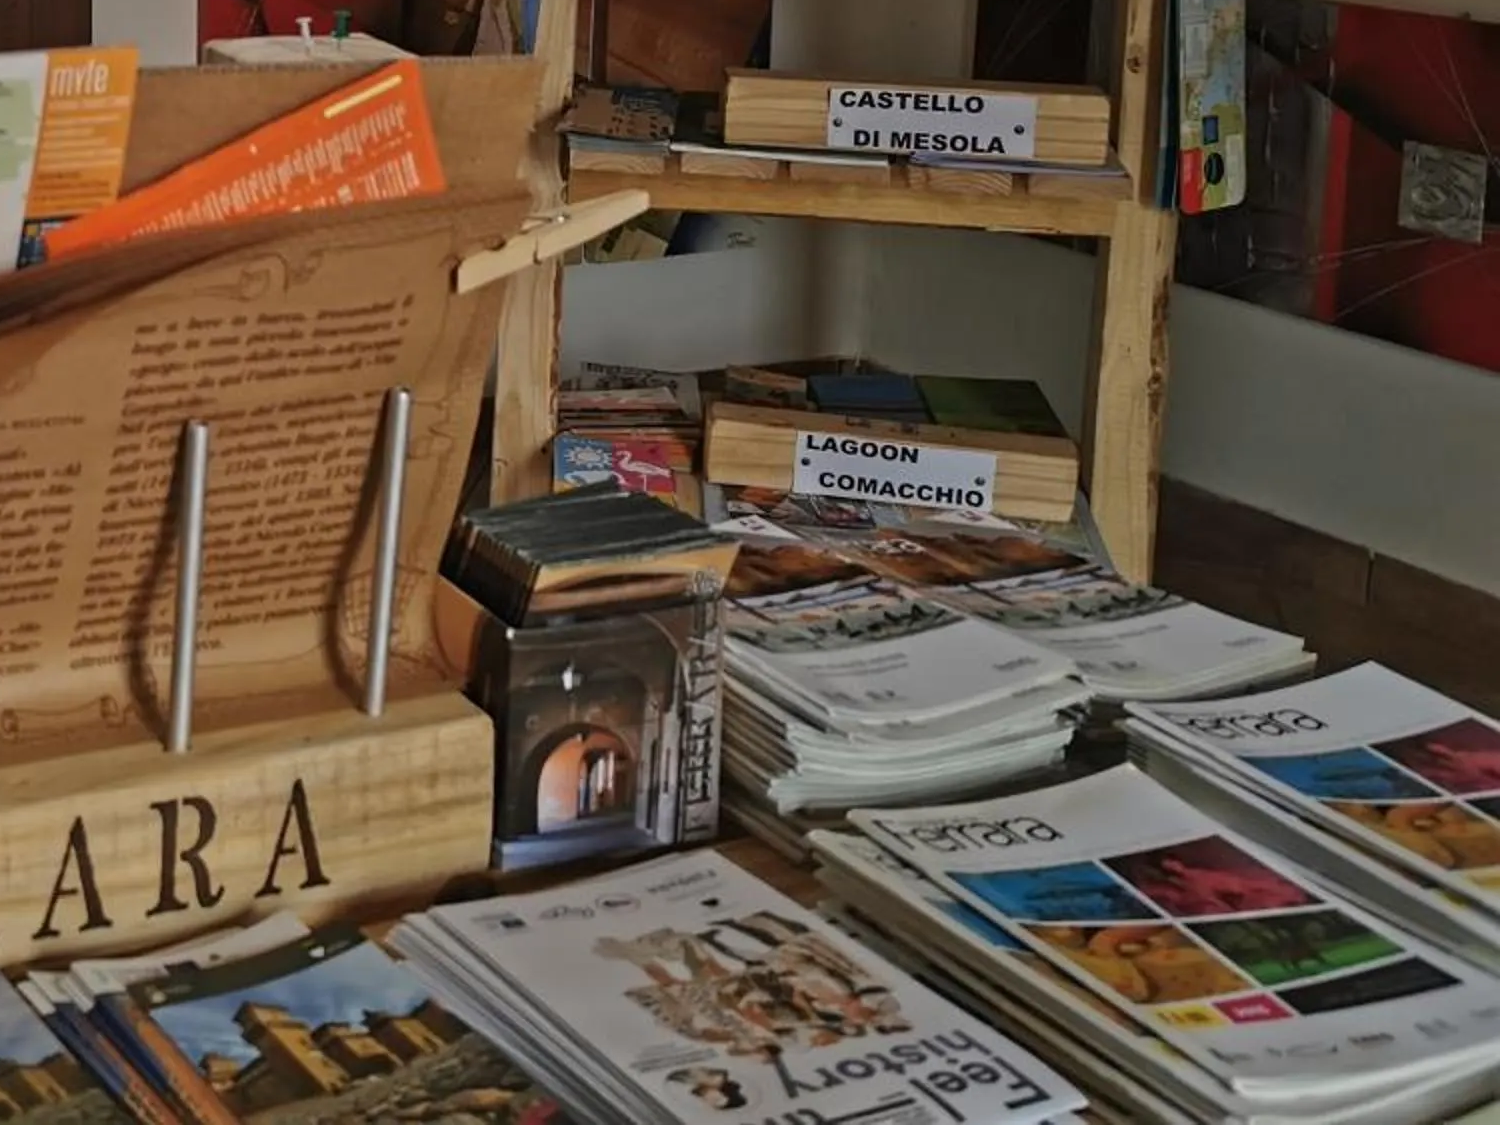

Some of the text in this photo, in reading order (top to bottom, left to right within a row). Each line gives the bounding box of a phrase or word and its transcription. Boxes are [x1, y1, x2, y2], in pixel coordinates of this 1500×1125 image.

[840, 90, 985, 114] CASTELLO
[853, 130, 1006, 154] DI MESOLA
[806, 434, 920, 464] LAGOON
[819, 472, 985, 508] COMACCHIO
[776, 1029, 992, 1100] history
[909, 1055, 1052, 1124] Feel
